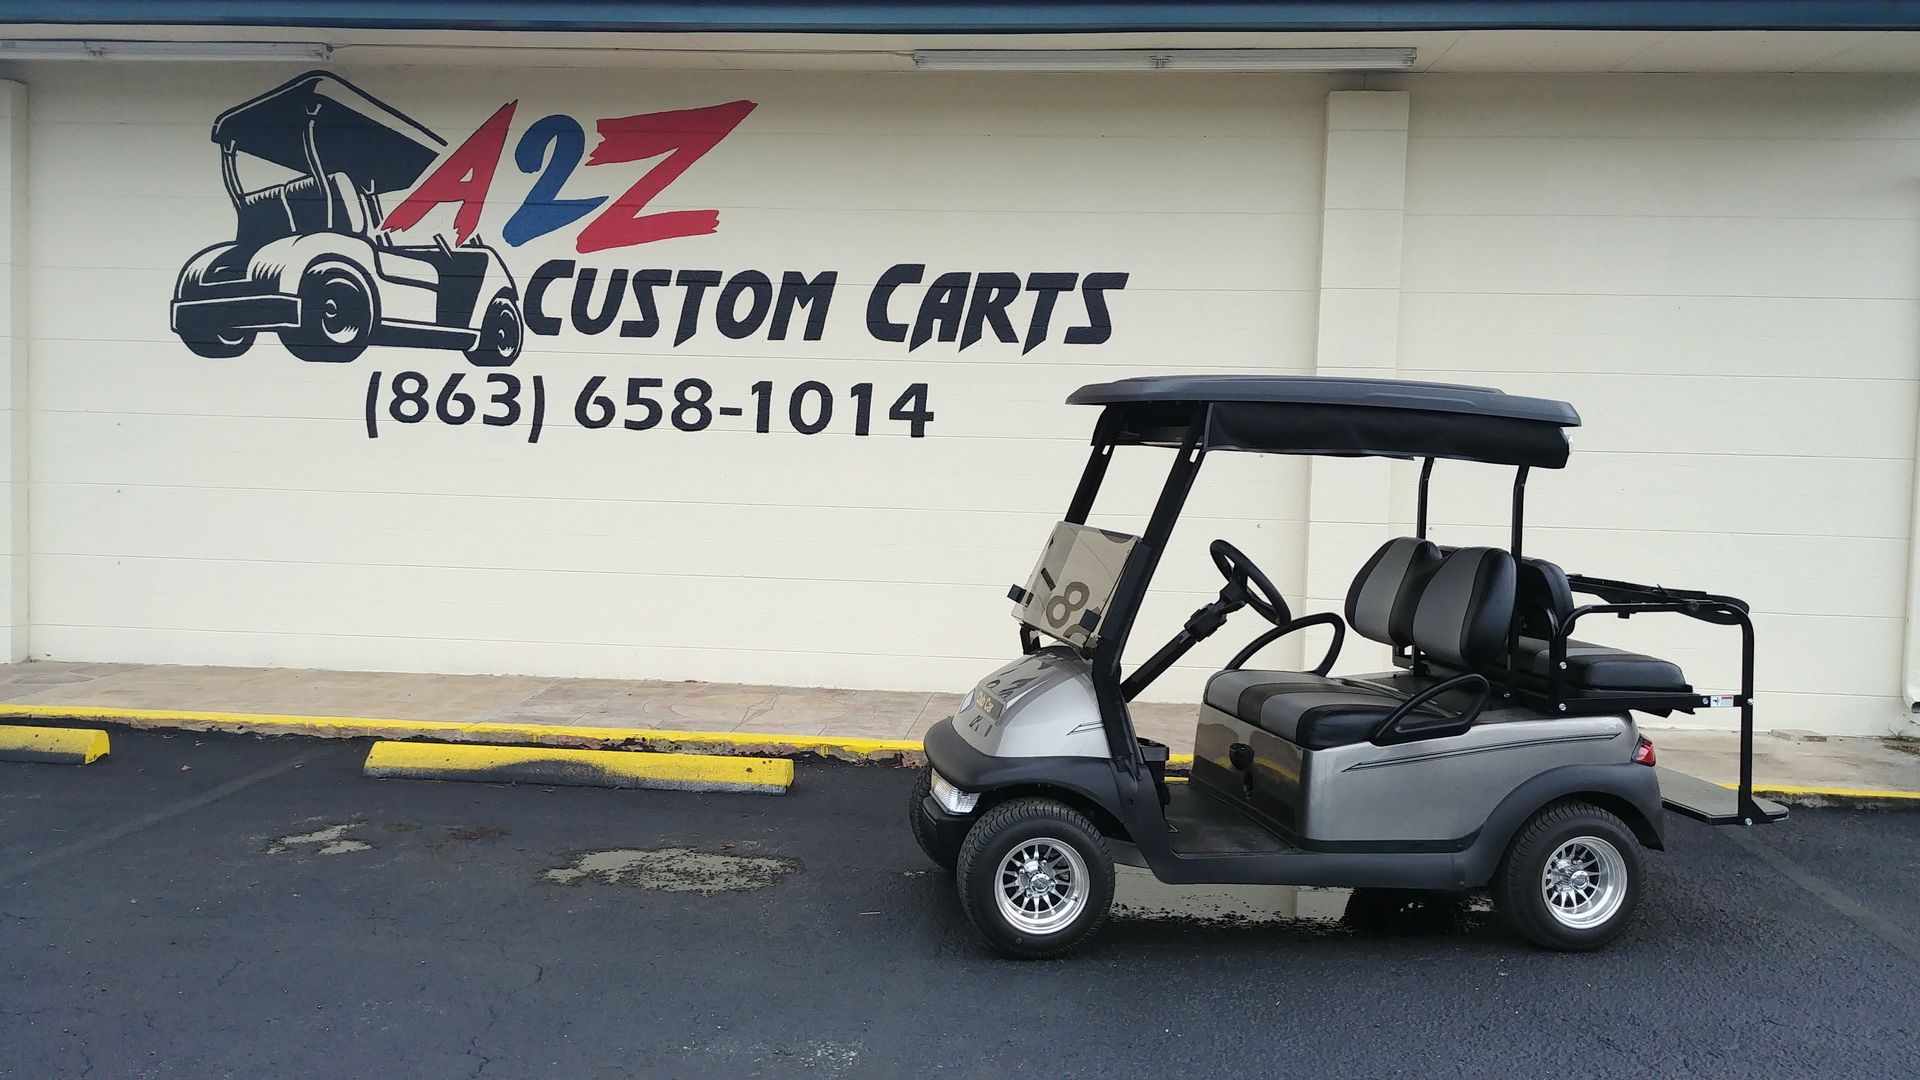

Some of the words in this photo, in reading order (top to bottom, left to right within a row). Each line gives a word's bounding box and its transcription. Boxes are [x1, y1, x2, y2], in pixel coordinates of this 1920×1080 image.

[382, 99, 758, 254] A2Z
[522, 259, 839, 348] CUSTOM
[865, 263, 1130, 357] CARTS
[365, 371, 545, 444] (863)
[574, 375, 935, 438] 658-1014
